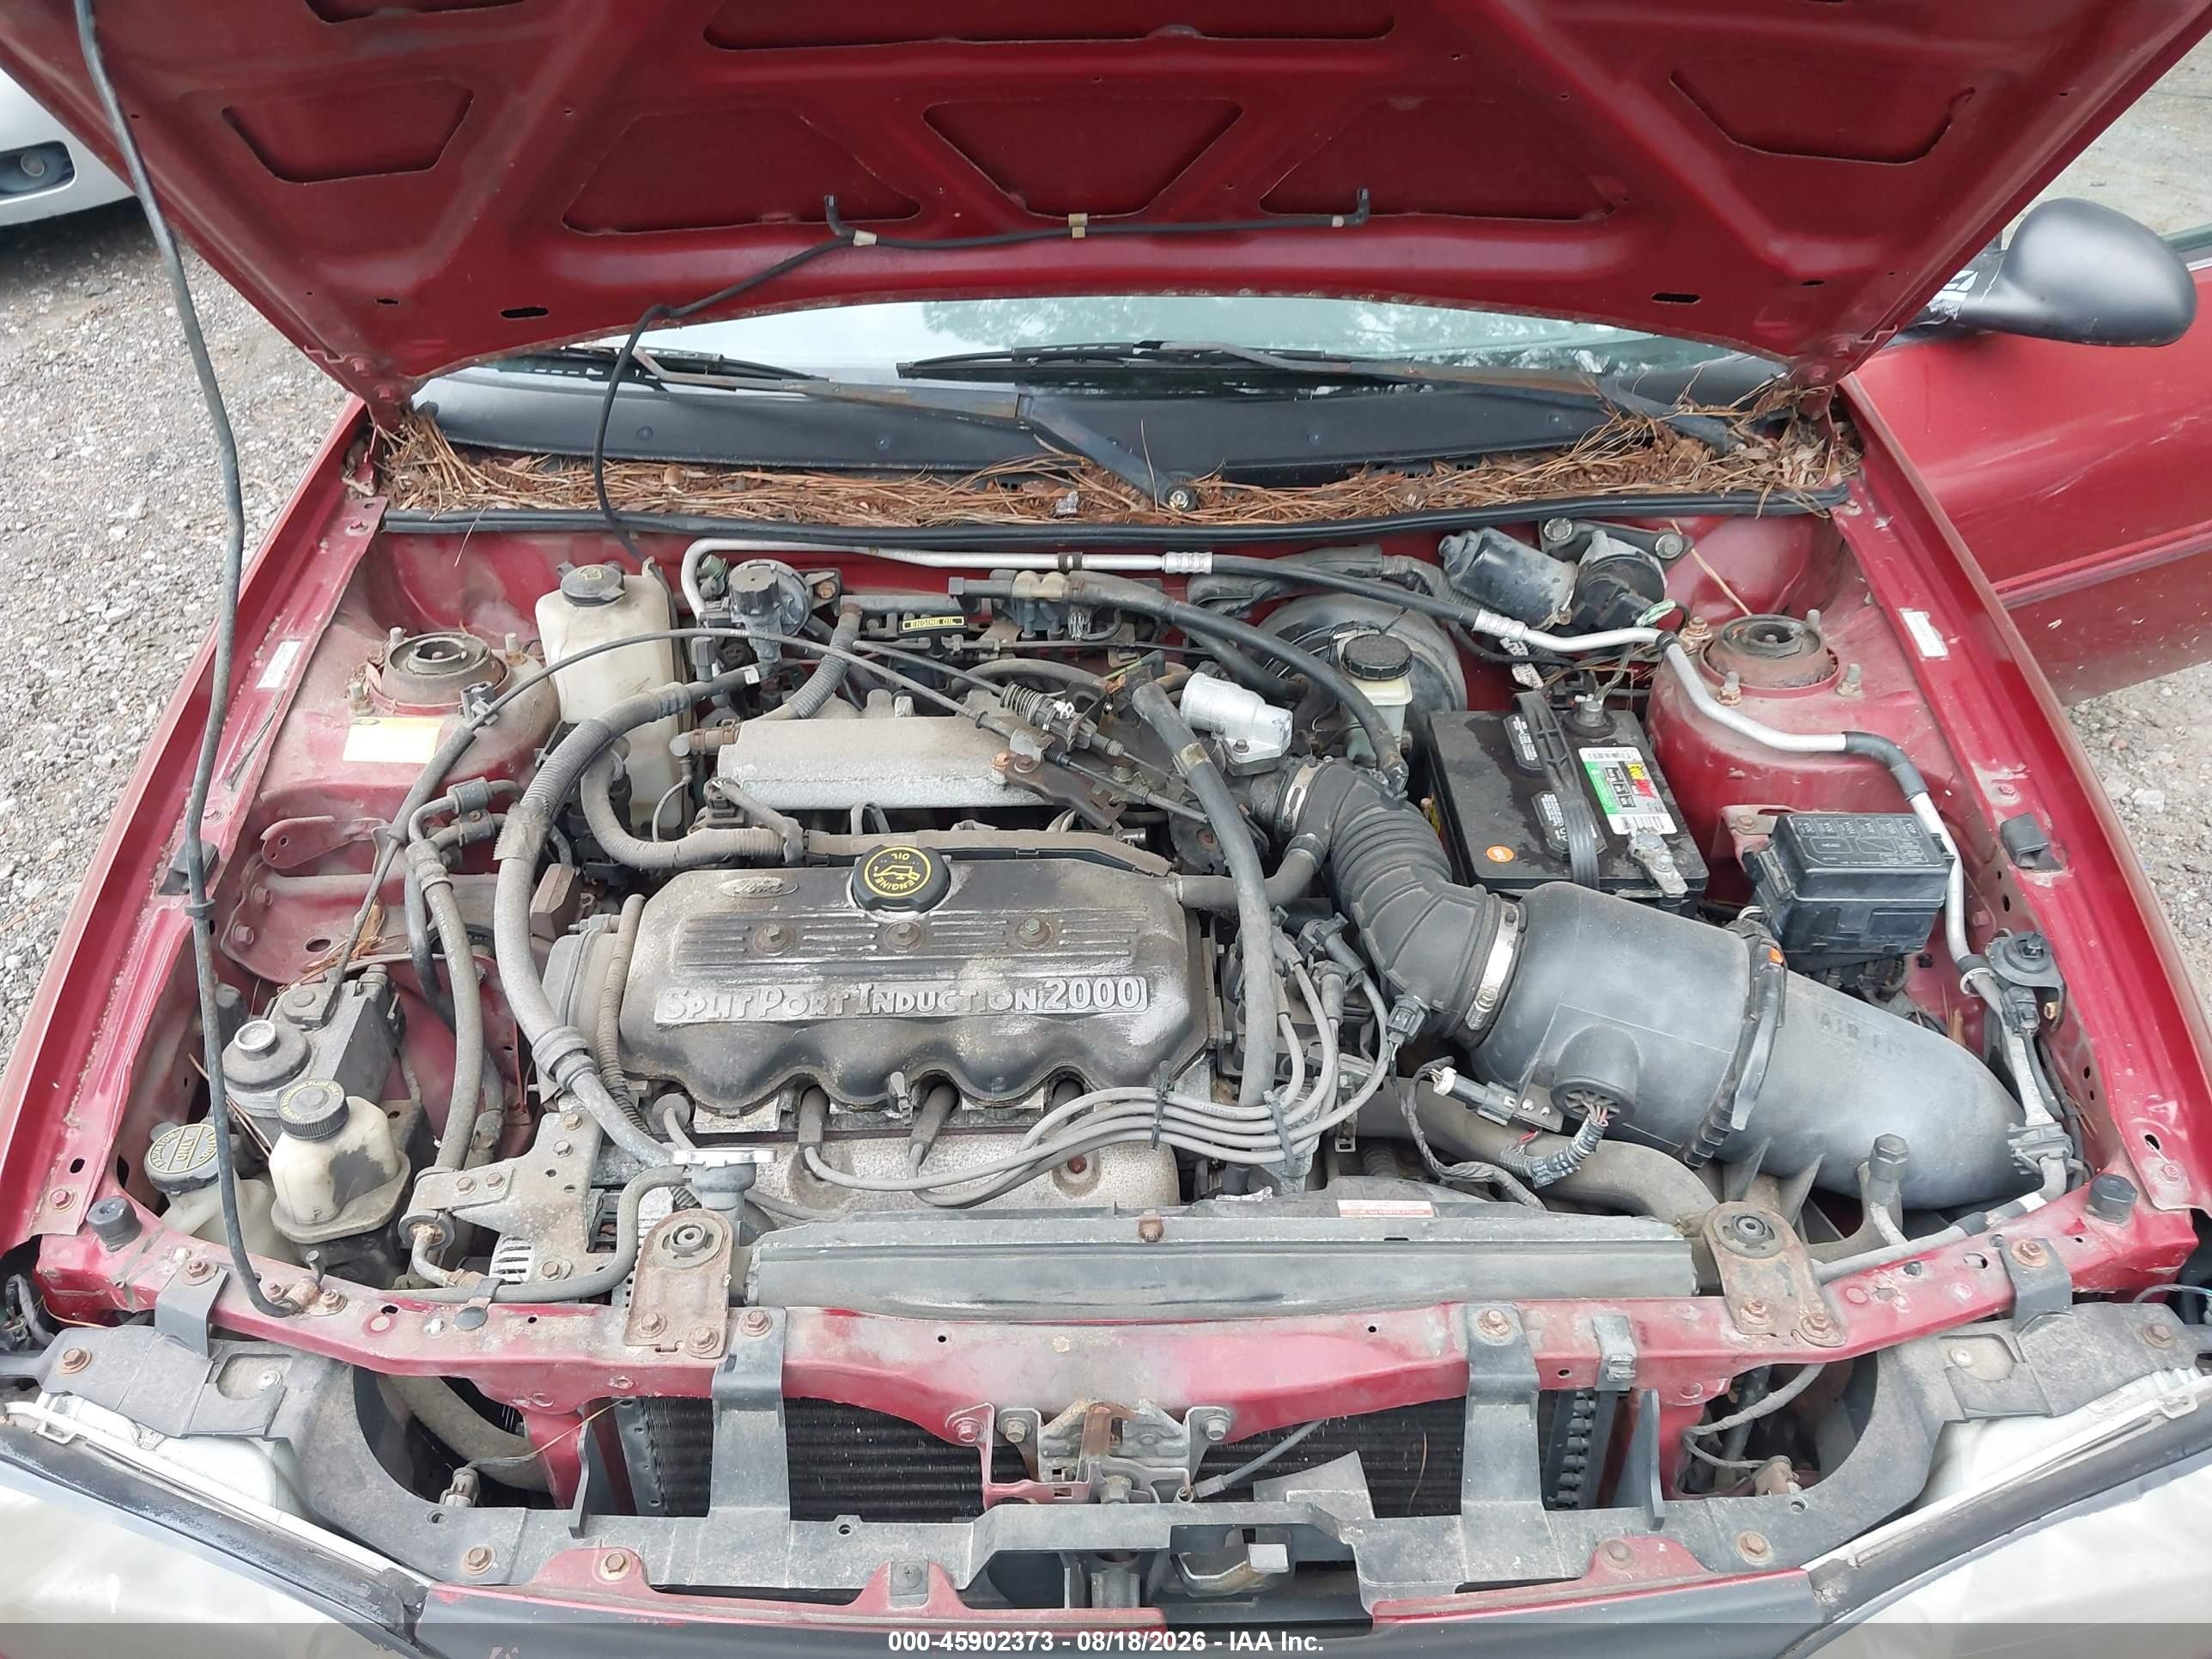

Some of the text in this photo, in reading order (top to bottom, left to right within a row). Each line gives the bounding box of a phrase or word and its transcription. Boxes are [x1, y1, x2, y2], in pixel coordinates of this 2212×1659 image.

[890, 852, 911, 860] OIL
[875, 876, 915, 890] ENGINE
[665, 975, 1140, 1019] SPLIT PORT INDUCTION 2000
[176, 1135, 196, 1162] ONLY
